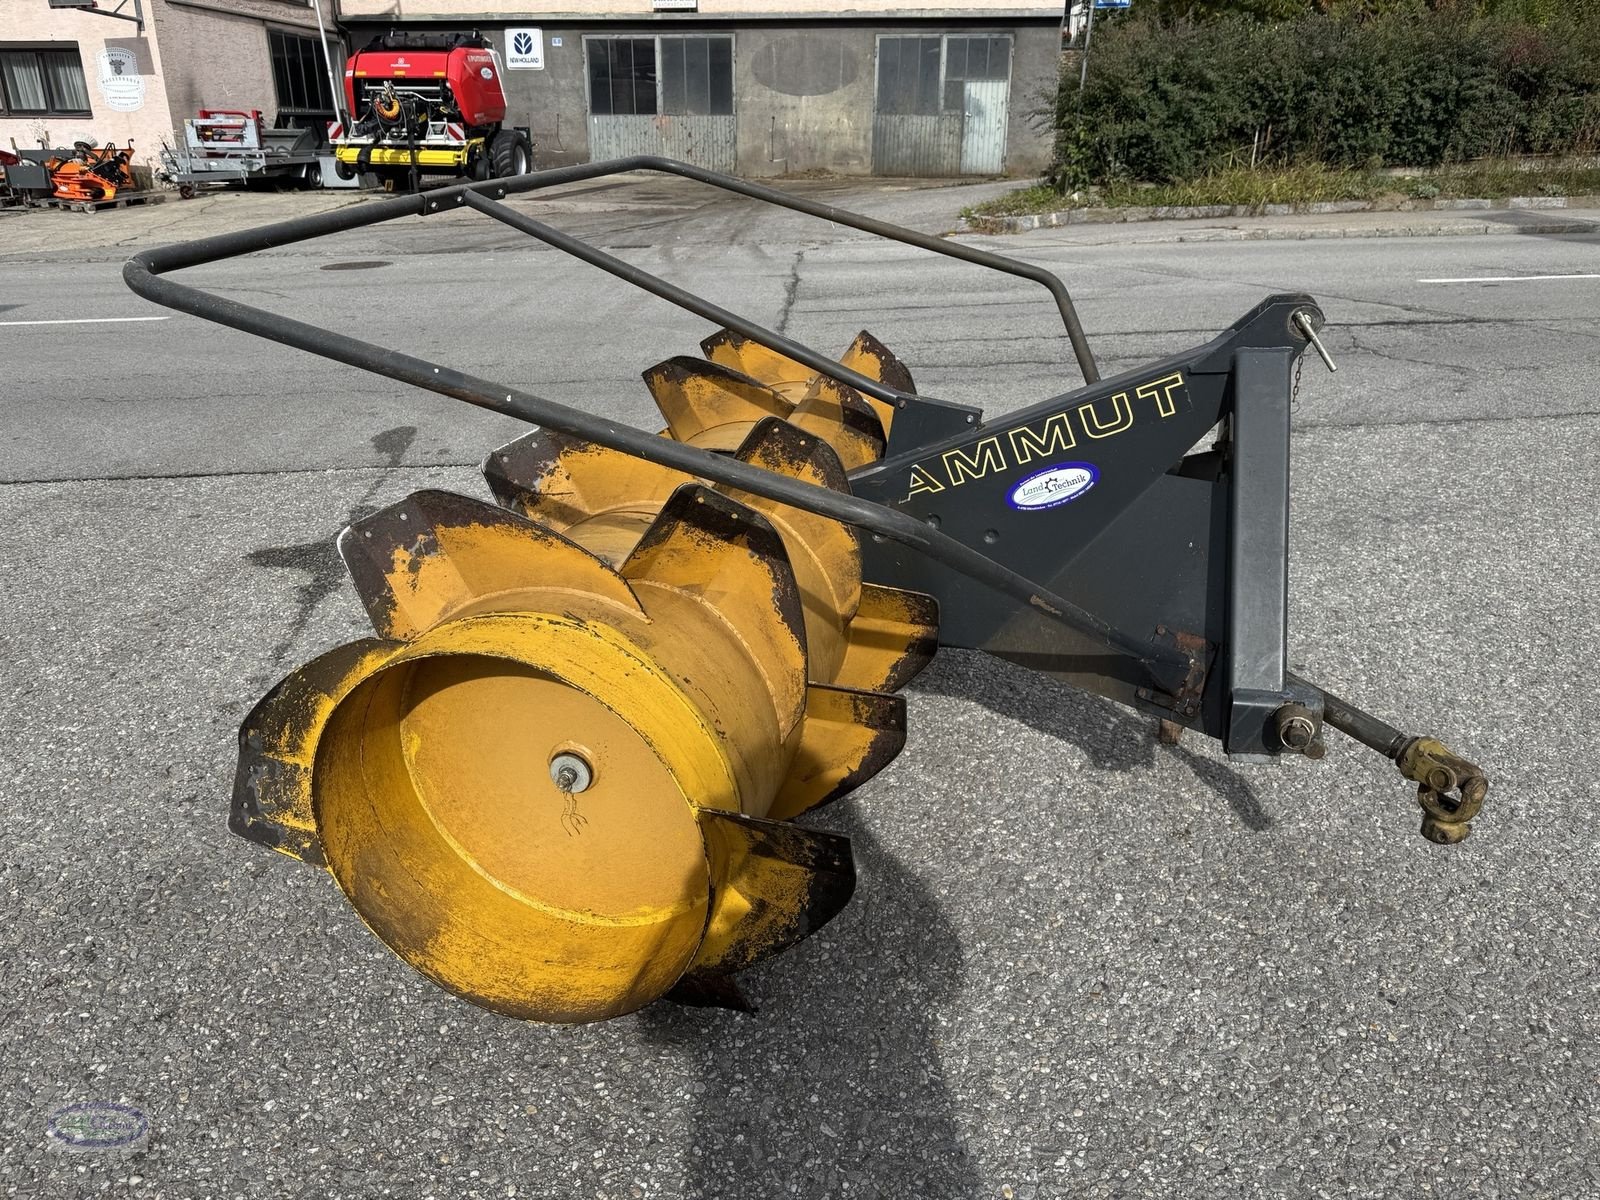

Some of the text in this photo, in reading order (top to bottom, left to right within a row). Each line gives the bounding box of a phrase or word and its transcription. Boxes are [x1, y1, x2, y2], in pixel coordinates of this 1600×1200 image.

[898, 371, 1185, 504] AMMUT
[1022, 482, 1044, 497] Land
[1051, 474, 1087, 492] Technik
